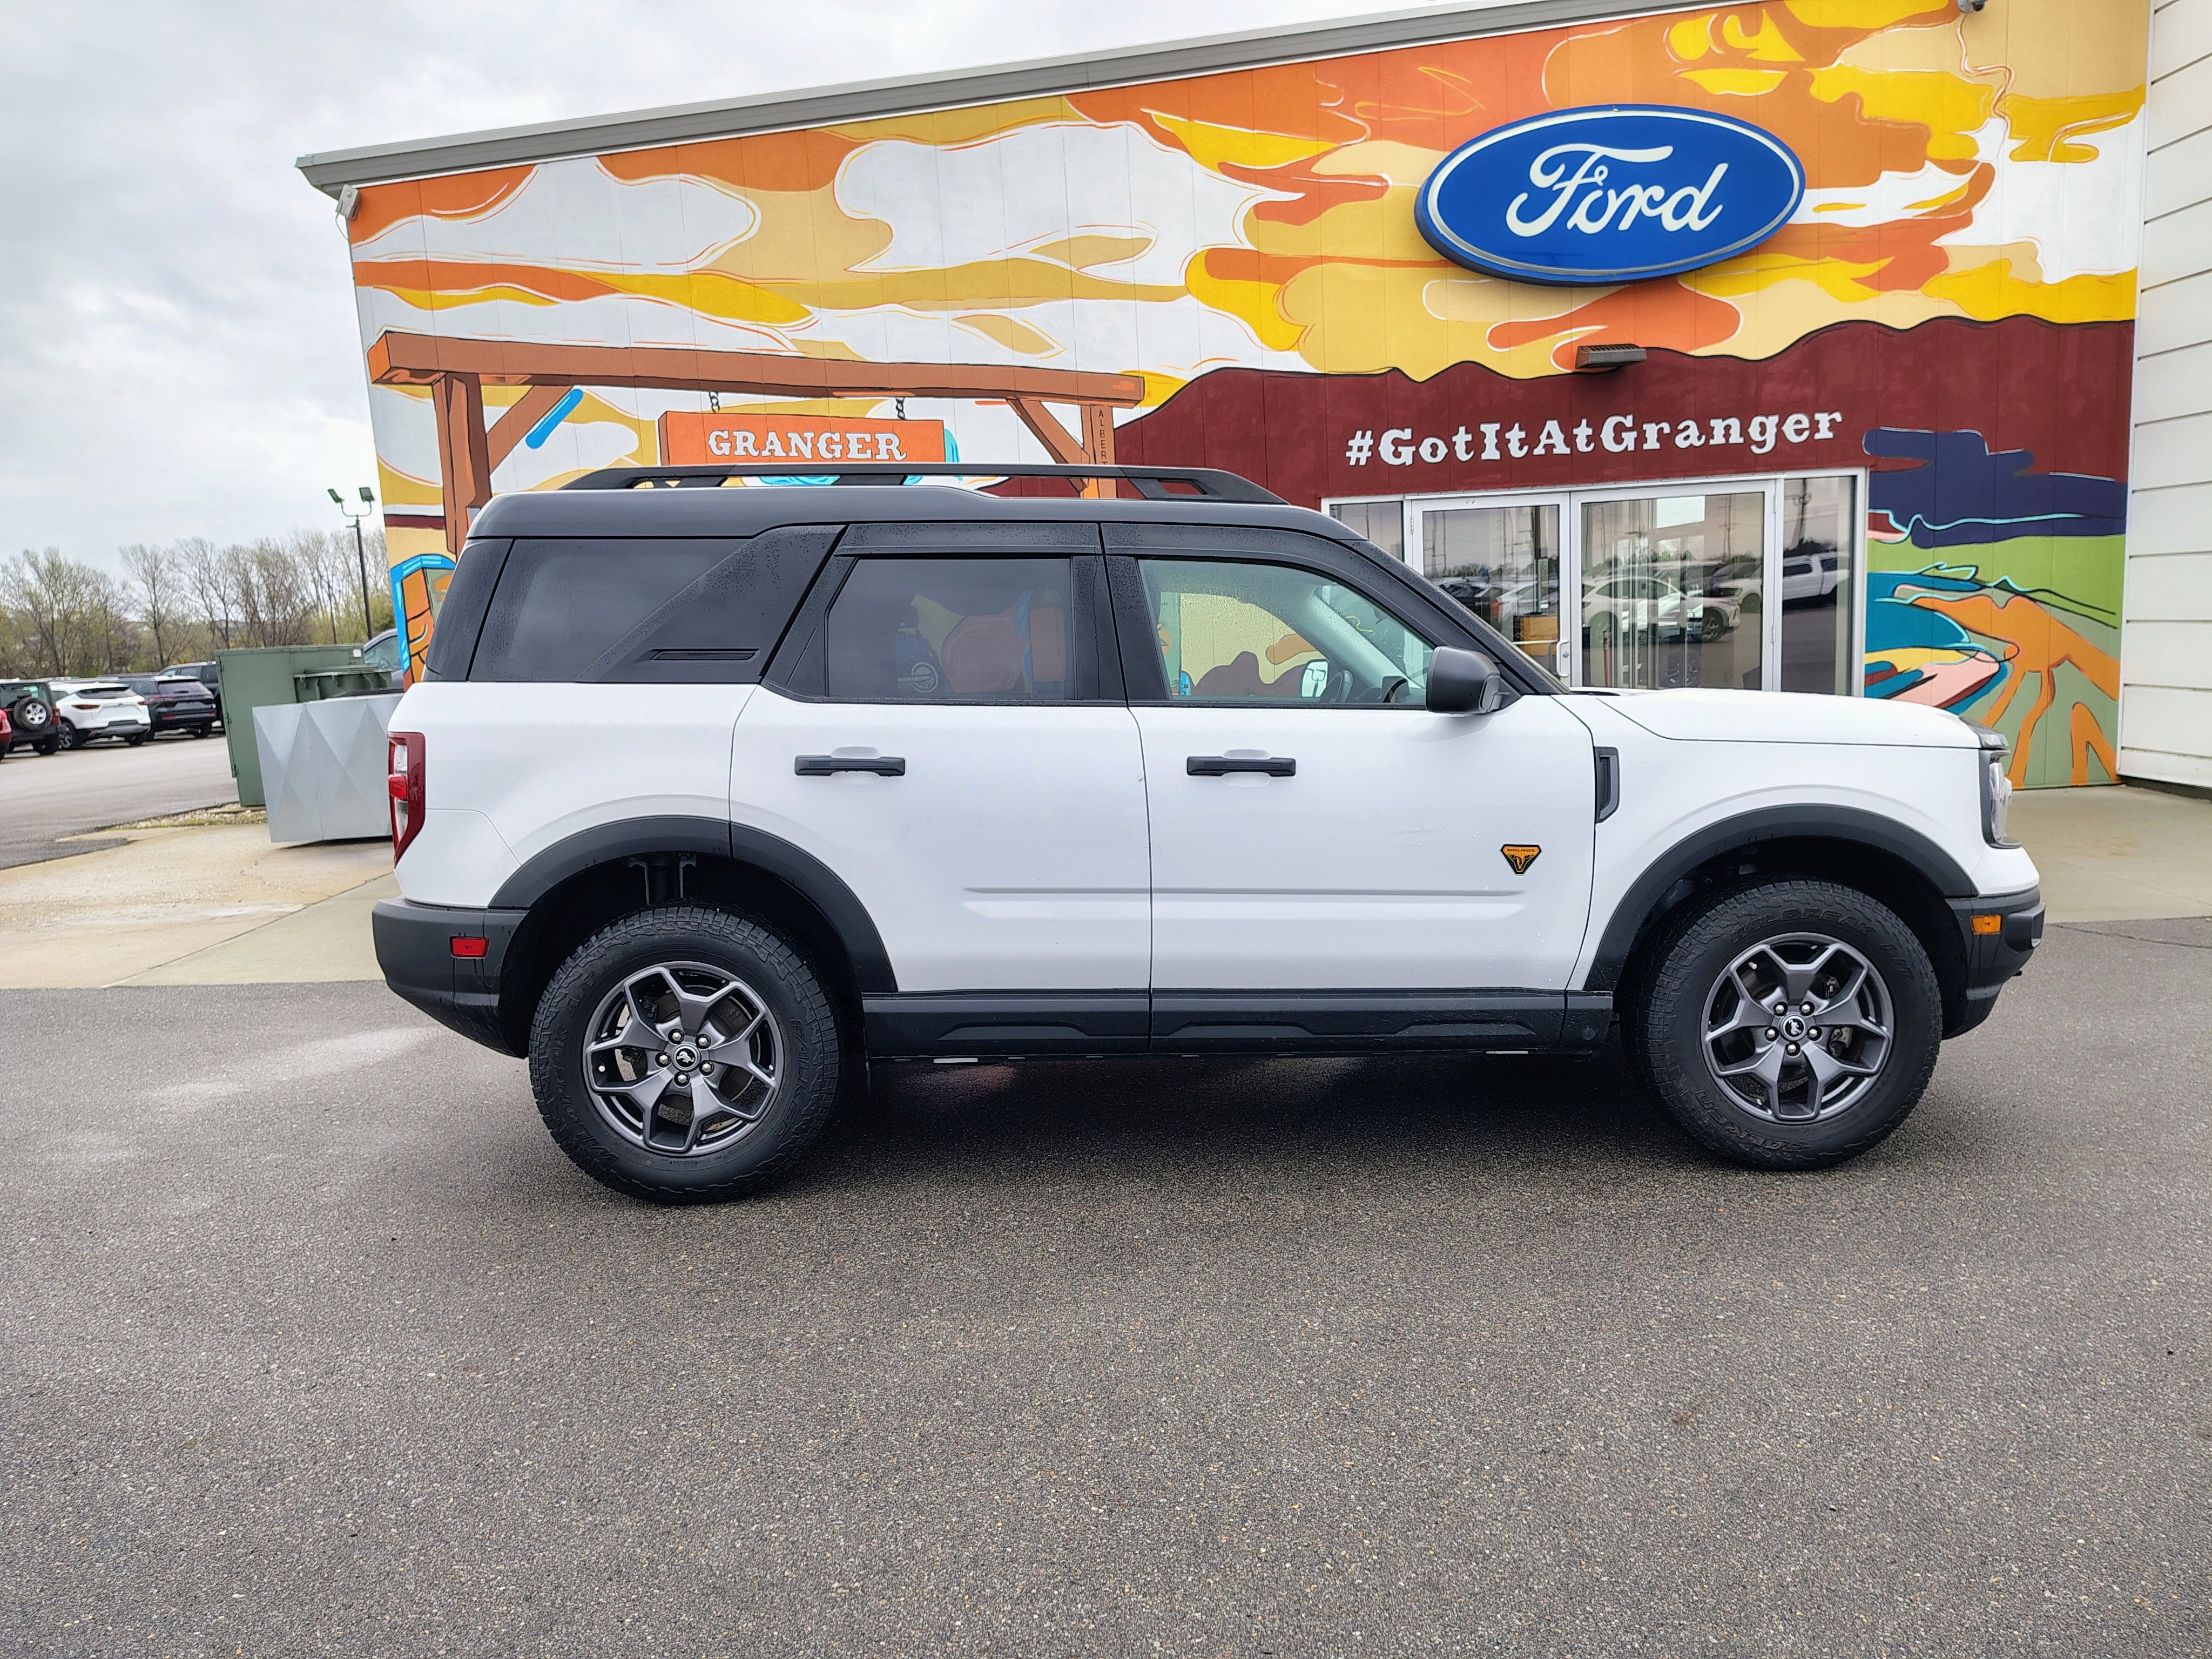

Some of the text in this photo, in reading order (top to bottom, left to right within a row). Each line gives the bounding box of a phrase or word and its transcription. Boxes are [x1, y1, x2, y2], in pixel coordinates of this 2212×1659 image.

[1506, 143, 1729, 237] Ford
[708, 429, 907, 461] GRANGER
[1345, 410, 1843, 467] #GotItAtGranger
